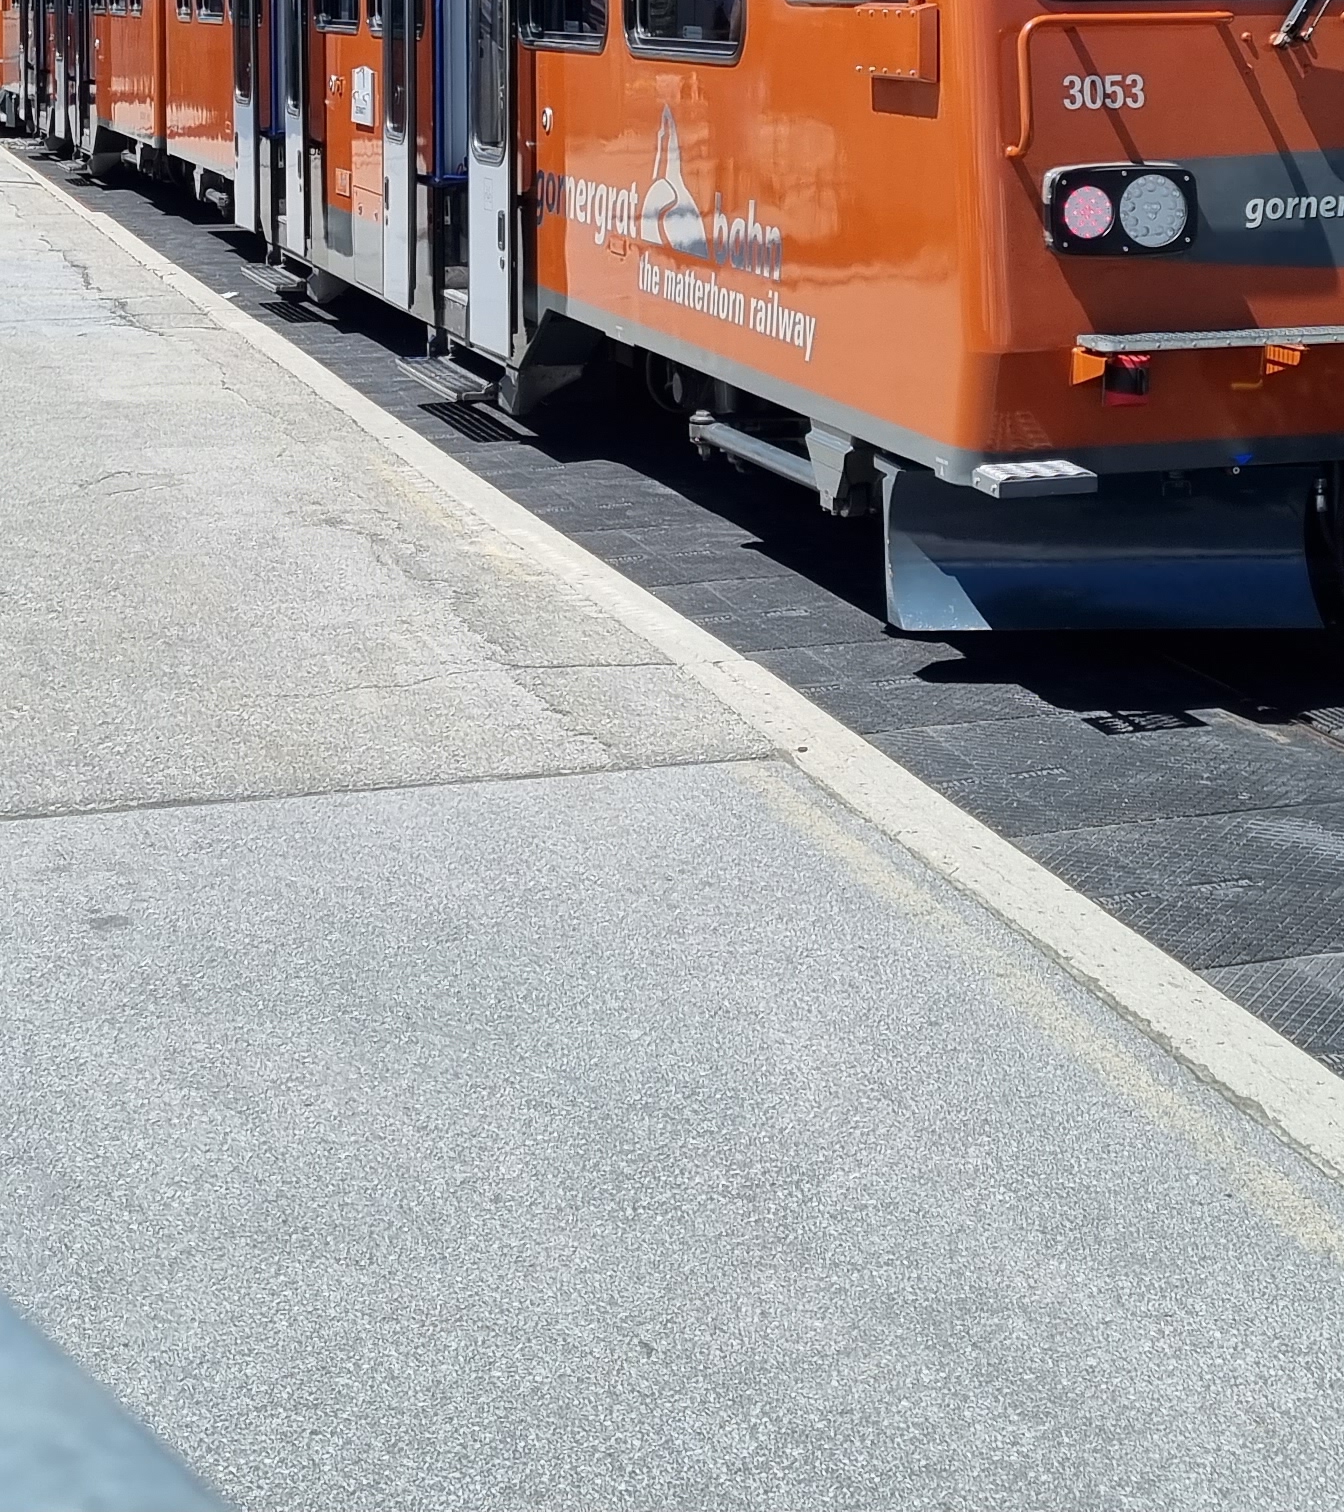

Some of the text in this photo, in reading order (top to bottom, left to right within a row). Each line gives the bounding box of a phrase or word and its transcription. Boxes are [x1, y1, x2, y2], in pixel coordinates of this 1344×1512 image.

[1063, 74, 1145, 110] 3053
[536, 169, 782, 281] gornergrat bahn
[638, 251, 817, 362] the matterhorn railway
